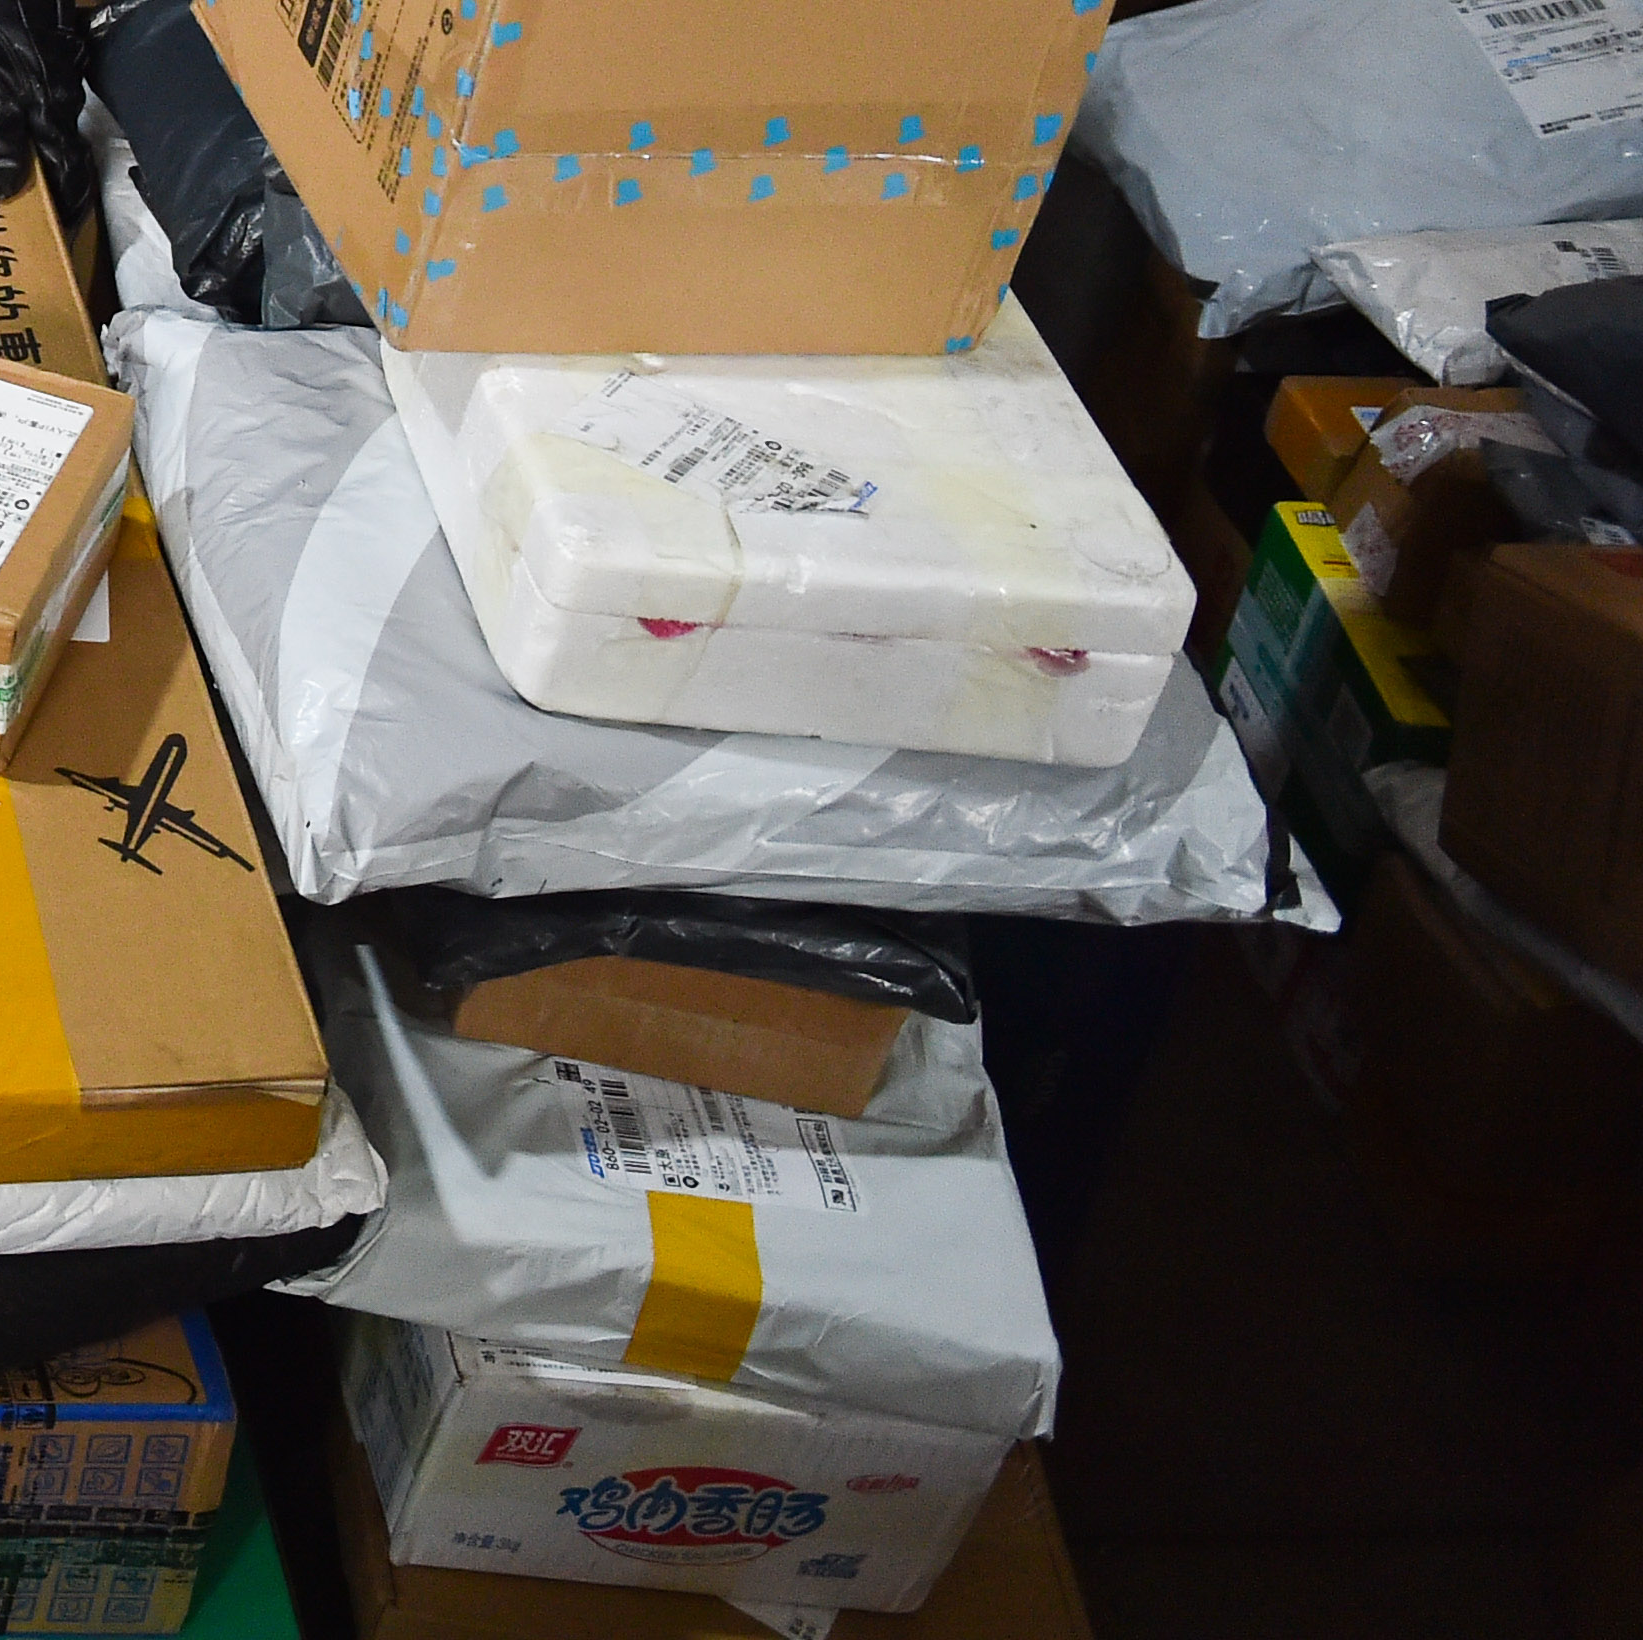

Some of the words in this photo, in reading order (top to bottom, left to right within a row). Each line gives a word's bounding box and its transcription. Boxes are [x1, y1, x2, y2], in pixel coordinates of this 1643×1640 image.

[582, 1078, 596, 1094] 49
[590, 1100, 610, 1134] 02-02
[602, 1140, 619, 1171] 860-
[503, 1427, 567, 1457] 双汇
[557, 1476, 829, 1536] 鸡肉香肠
